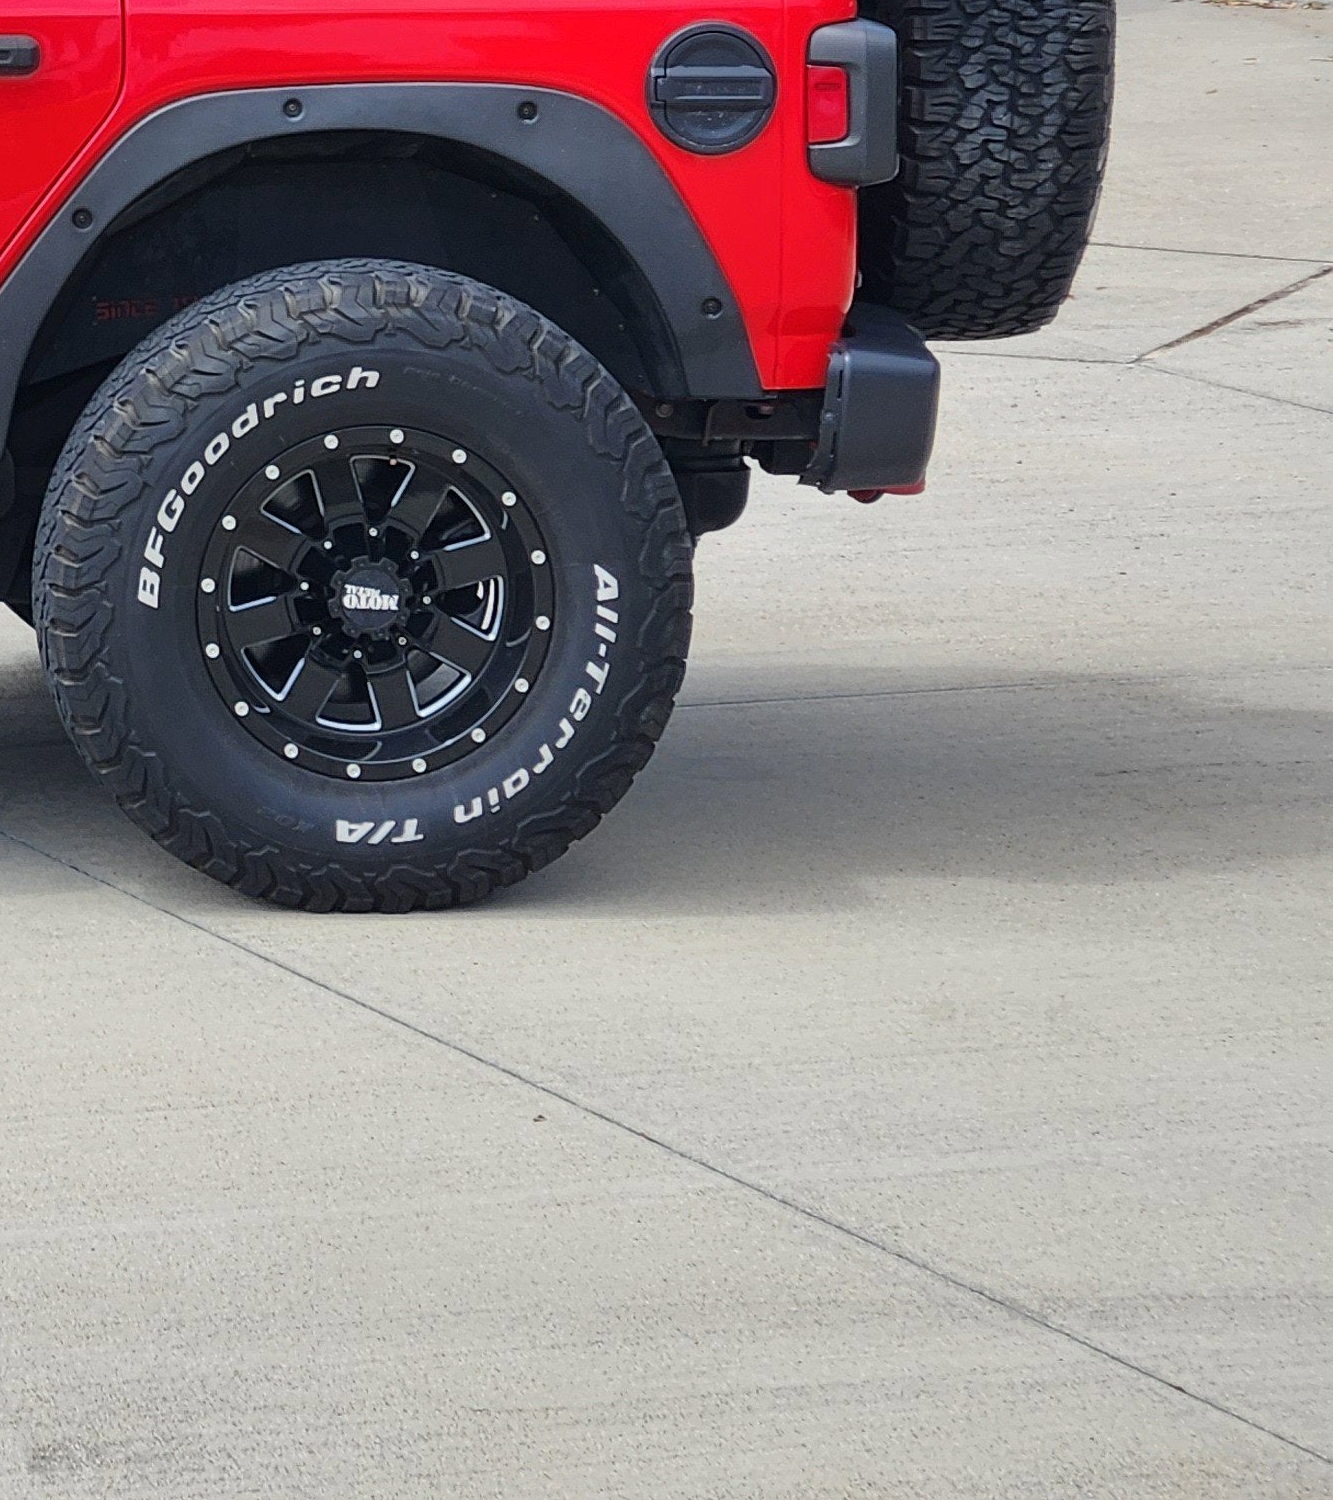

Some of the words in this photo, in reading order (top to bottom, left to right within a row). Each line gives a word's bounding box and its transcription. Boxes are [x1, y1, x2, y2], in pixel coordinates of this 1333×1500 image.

[137, 366, 380, 609] BFGoodrich
[342, 593, 400, 611] MOTO
[453, 563, 620, 824] All-Terrain
[335, 817, 425, 845] T/A
